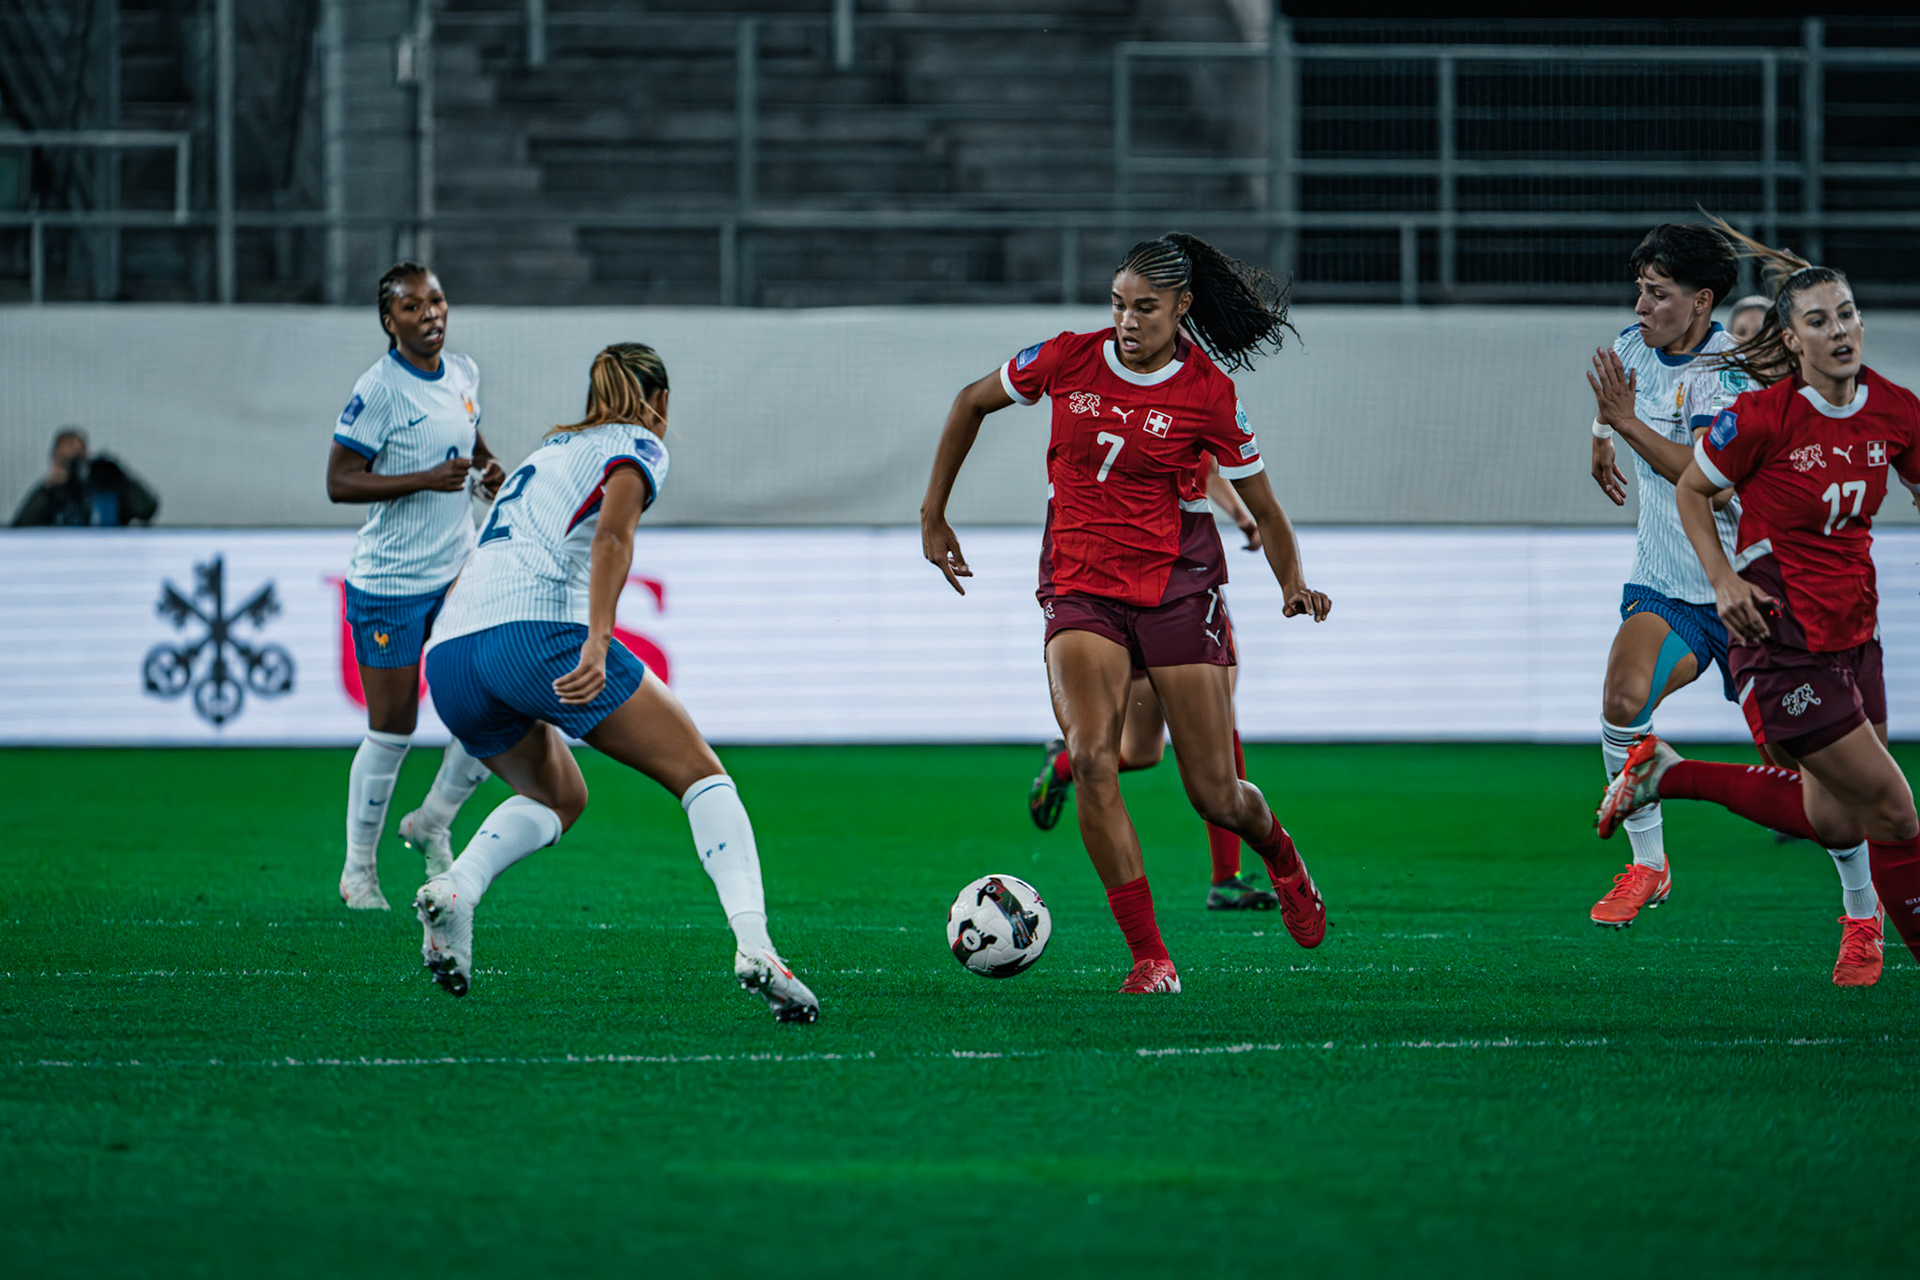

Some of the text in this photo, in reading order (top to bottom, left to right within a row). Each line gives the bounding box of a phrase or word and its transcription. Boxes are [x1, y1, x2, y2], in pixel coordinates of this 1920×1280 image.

[1096, 431, 1125, 482] 7
[477, 464, 536, 547] 2
[1822, 480, 1866, 536] 17
